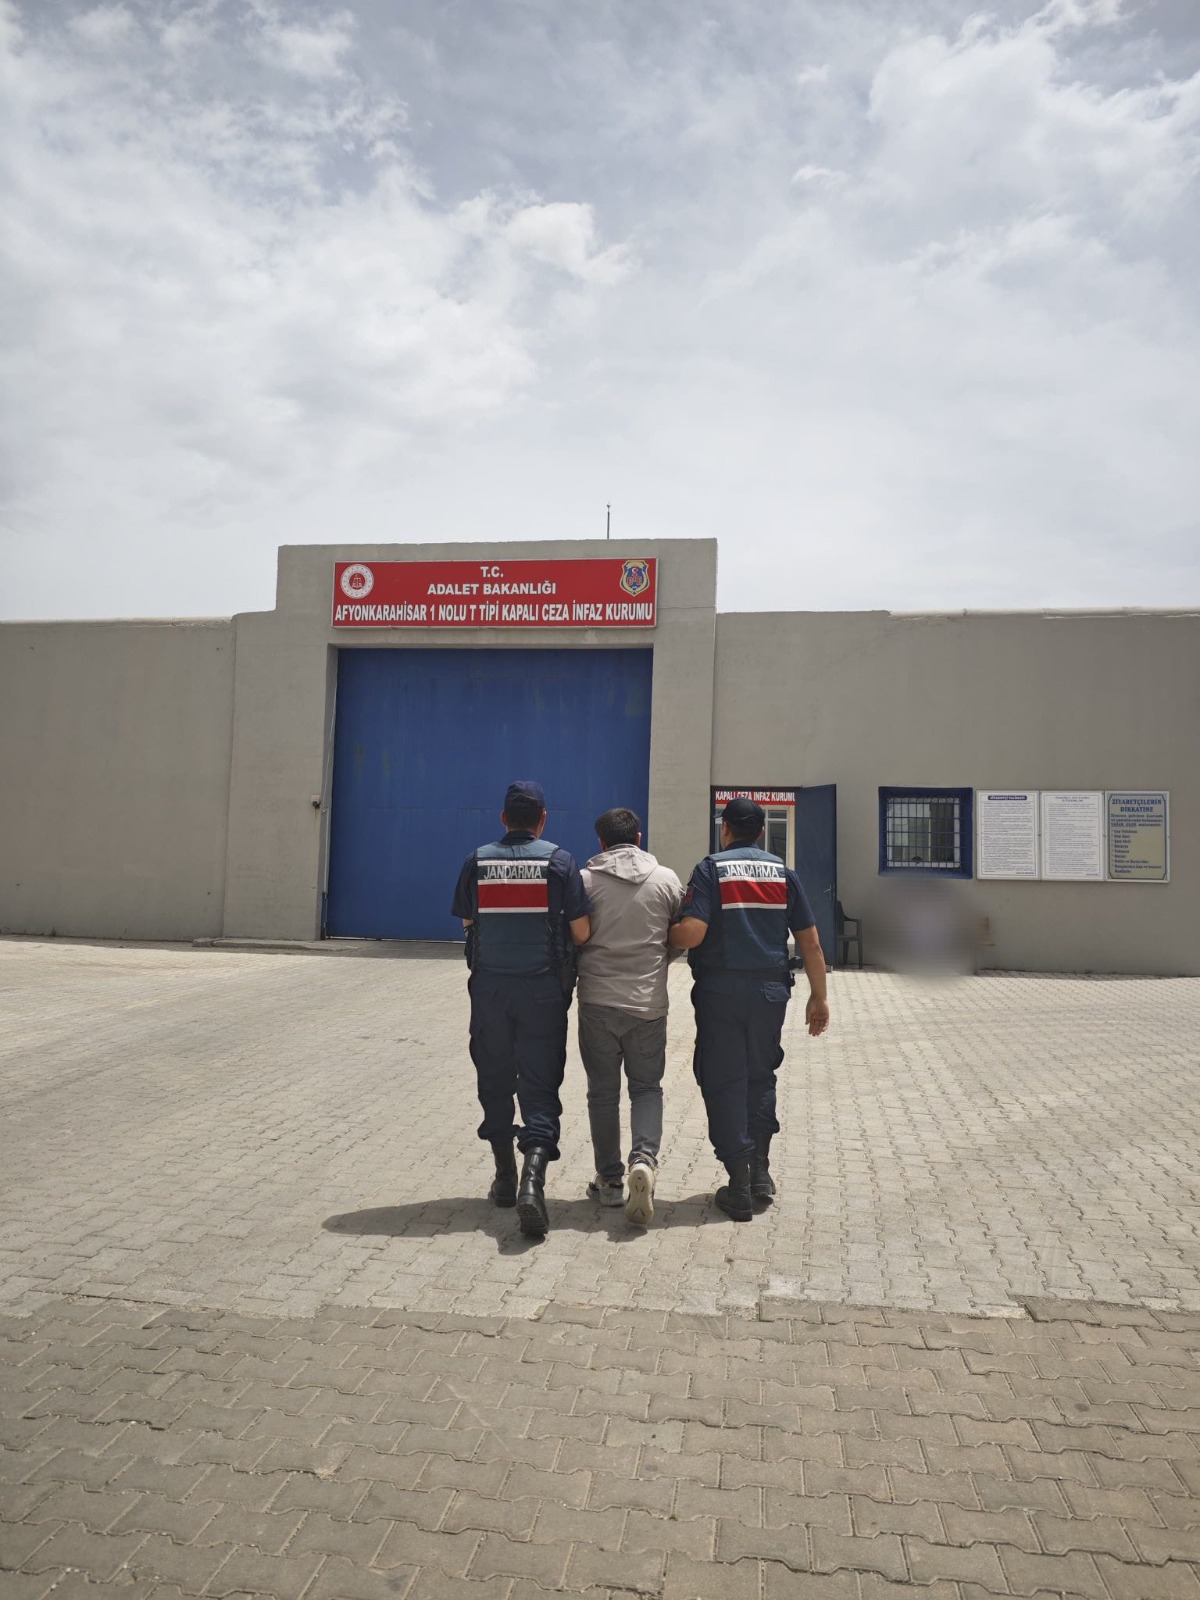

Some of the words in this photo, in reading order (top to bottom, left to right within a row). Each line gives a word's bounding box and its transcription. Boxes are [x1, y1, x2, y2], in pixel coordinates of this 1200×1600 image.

[480, 566, 504, 578] T.C.
[427, 583, 480, 595] ADALET
[483, 579, 557, 595] BAKANLIĞI
[335, 600, 427, 621] AFYONKARAHİSAR
[430, 604, 435, 621] 1
[438, 604, 467, 621] NOLU
[469, 604, 477, 621] T
[479, 600, 499, 621] TİPİ
[502, 604, 539, 621] KAPALI
[541, 603, 570, 621] CEZA
[572, 599, 603, 621] İNFAZ
[605, 603, 653, 621] KURUMU
[715, 791, 736, 800] KAPALI
[483, 865, 543, 880] JANDARMA
[724, 864, 780, 878] JANDARMA
